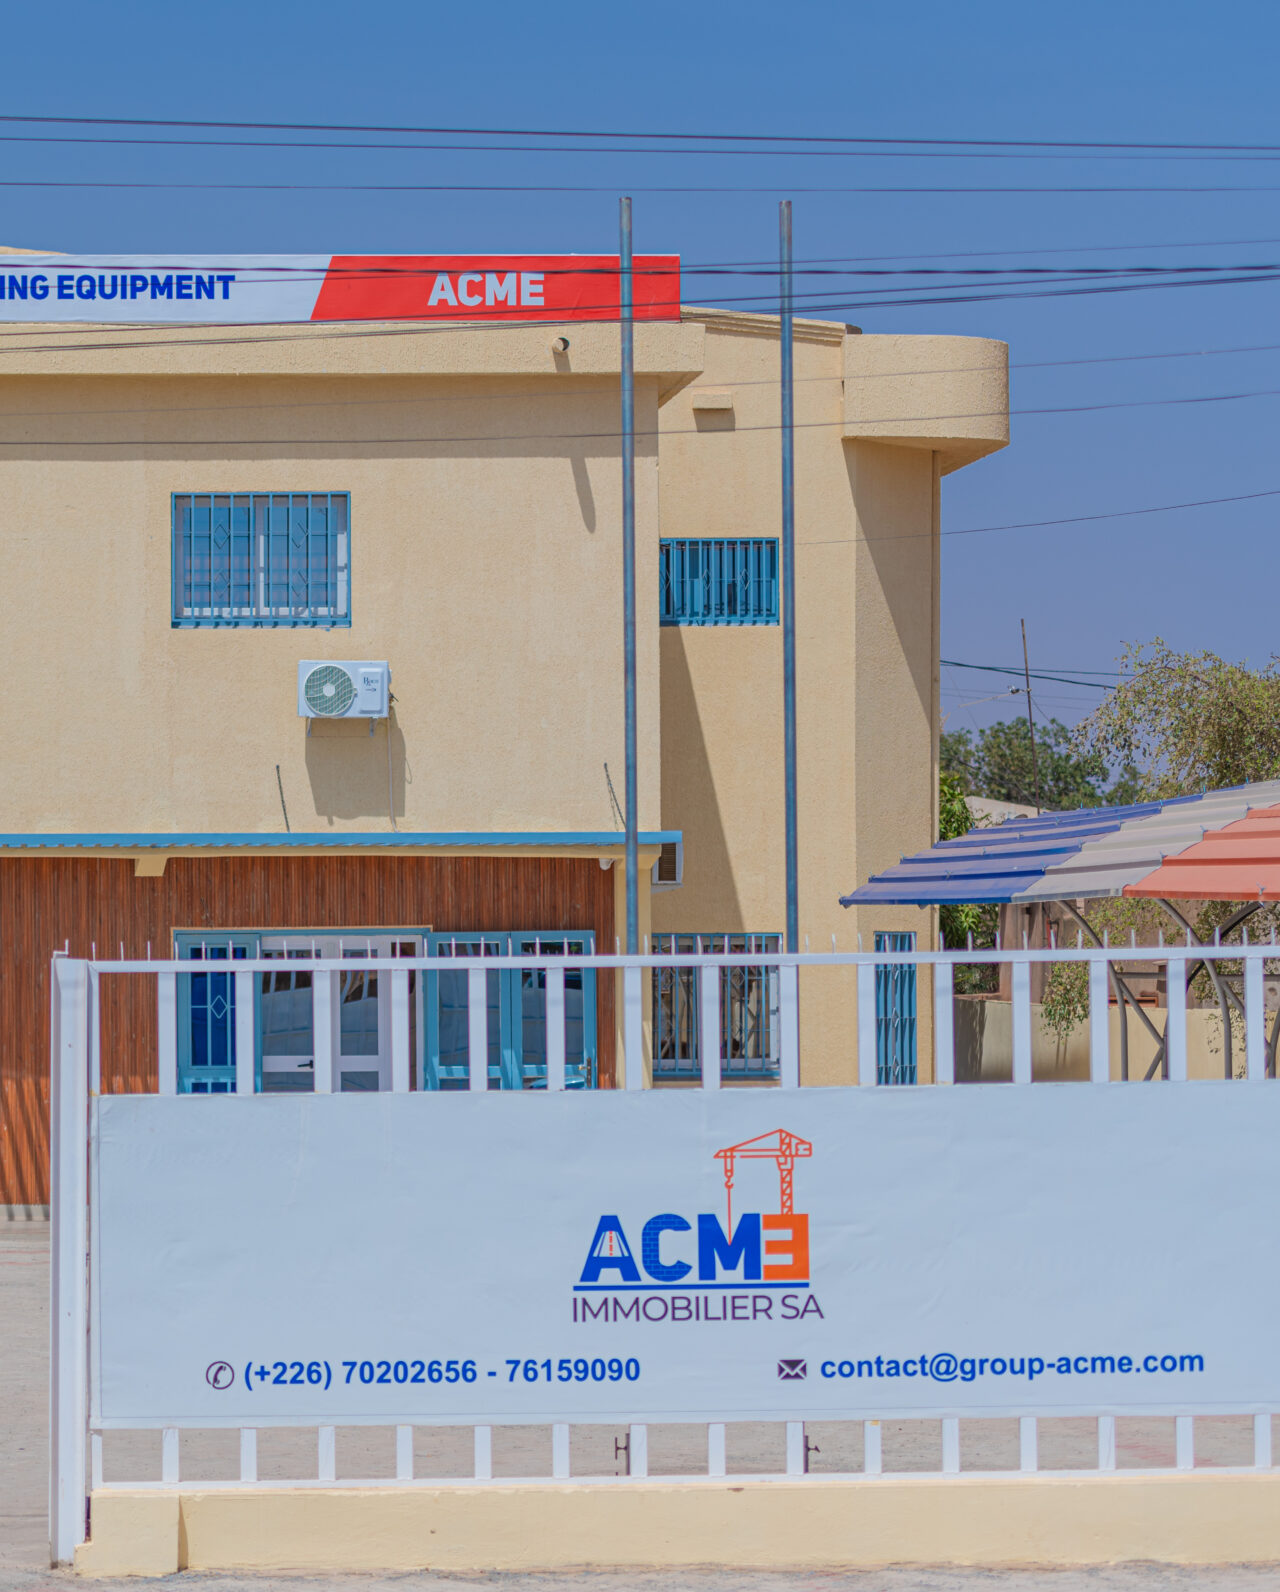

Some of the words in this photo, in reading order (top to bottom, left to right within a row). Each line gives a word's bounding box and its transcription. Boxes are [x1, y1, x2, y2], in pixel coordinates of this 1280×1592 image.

[57, 274, 236, 300] EQUIPMENT
[427, 272, 545, 306] ACME
[572, 1296, 773, 1323] IMMOBILIER
[781, 1294, 825, 1320] SA
[244, 1360, 333, 1392] (+226)
[341, 1359, 478, 1385] 70202656
[504, 1357, 641, 1383] 76159090
[820, 1351, 1205, 1384] contact@group-acme.com
